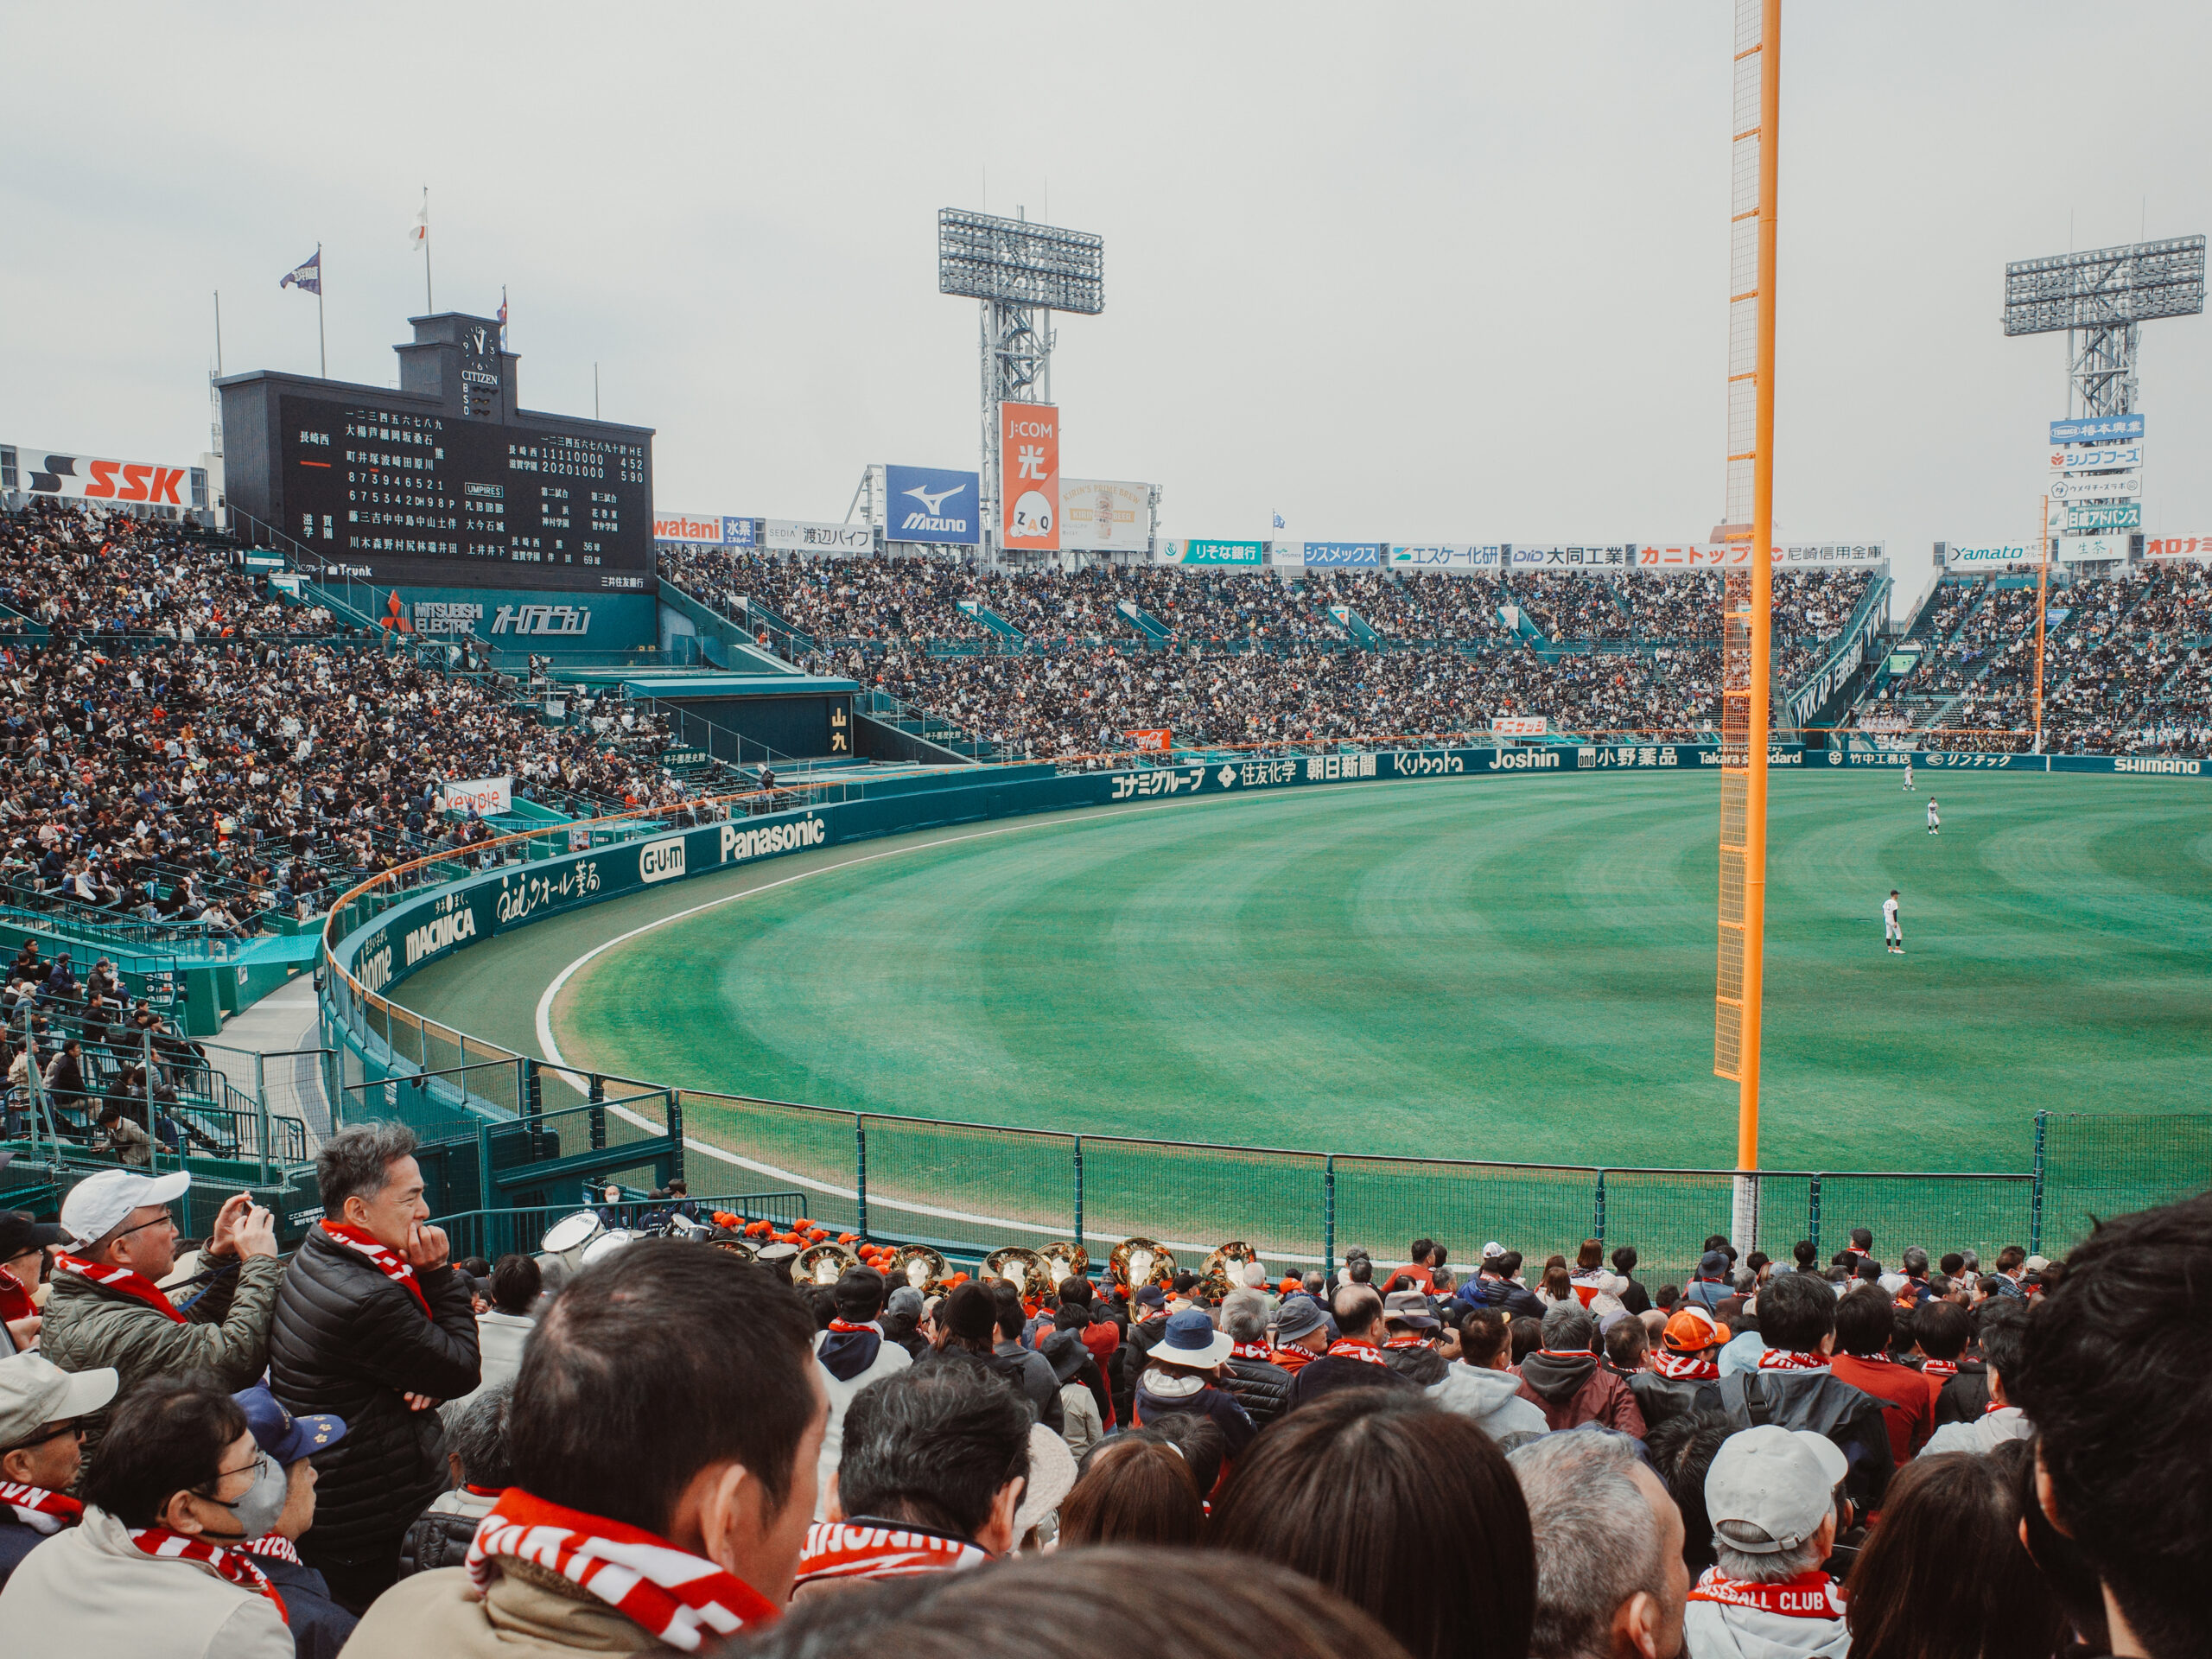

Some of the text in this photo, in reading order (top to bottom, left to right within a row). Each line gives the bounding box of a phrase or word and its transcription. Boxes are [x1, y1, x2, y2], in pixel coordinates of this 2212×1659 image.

[462, 371, 498, 385] CITIZEN
[463, 383, 468, 393] B
[463, 395, 469, 404] S
[1009, 420, 1052, 438] J:COM
[1018, 445, 1047, 480] 光
[2067, 448, 2140, 466] シノブフーズ
[85, 460, 186, 505] SSK
[467, 486, 501, 496] UMPIRES
[541, 486, 569, 499] 第二試合
[591, 492, 617, 504] 第三試合
[1063, 484, 1140, 505] KIRIN'S PRIME BREW
[727, 520, 752, 537] 水素
[769, 529, 795, 538] SEDIA
[803, 527, 872, 548] 渡辺パイプ
[1196, 544, 1255, 560] りそな銀行
[1306, 546, 1376, 563] シスメックス
[1412, 546, 1498, 564] エスケー化研
[1547, 547, 1624, 565] 大同工業
[1641, 545, 1751, 564] カニトップ
[1788, 545, 1882, 560] 尼崎信用金庫
[1951, 546, 2023, 561] Yamato
[2078, 540, 2107, 555] 生茶
[339, 563, 372, 576] Trunk
[601, 576, 644, 588] 三井住友銀行
[415, 602, 483, 619] MITSUBISHI
[416, 619, 476, 633] ELECTRIC
[832, 708, 847, 751] 山九
[1395, 751, 1464, 776] Kubota
[1489, 747, 1560, 769] Joshin
[1597, 747, 1678, 766] 小野薬品
[1698, 752, 1739, 764] Takara
[1849, 753, 1911, 765] 竹中工務店
[1948, 754, 2011, 767] リンテック
[1240, 761, 1296, 786] 住友化学
[1306, 754, 1376, 780] 朝日新聞
[2114, 759, 2200, 774] SHIMANO
[1112, 767, 1205, 798] コナミグループ
[447, 784, 499, 816] kewpie
[721, 811, 824, 863] Panasonic
[361, 945, 391, 992] home
[1694, 1583, 1824, 1611] BASEBALL CLUB
